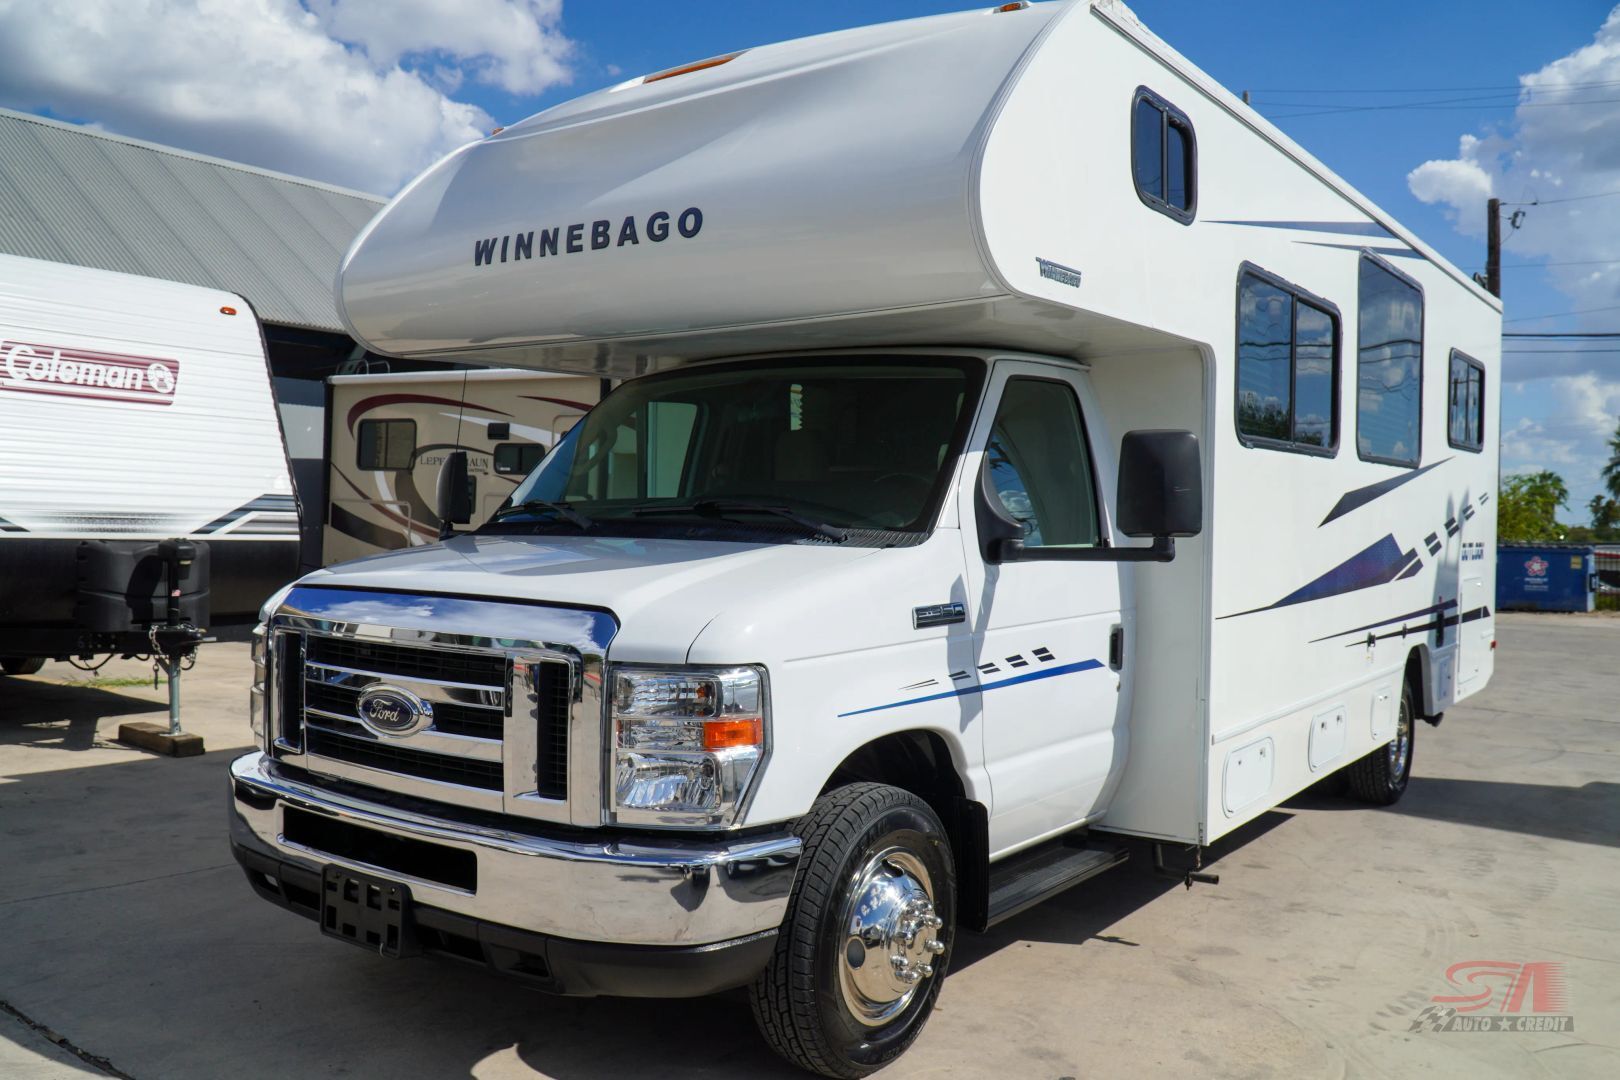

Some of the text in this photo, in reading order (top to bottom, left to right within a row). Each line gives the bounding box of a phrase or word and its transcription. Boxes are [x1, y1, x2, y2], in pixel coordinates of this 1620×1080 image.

[474, 207, 703, 267] WINNEBAGO
[6, 344, 143, 390] Coleman
[369, 698, 400, 722] Ford
